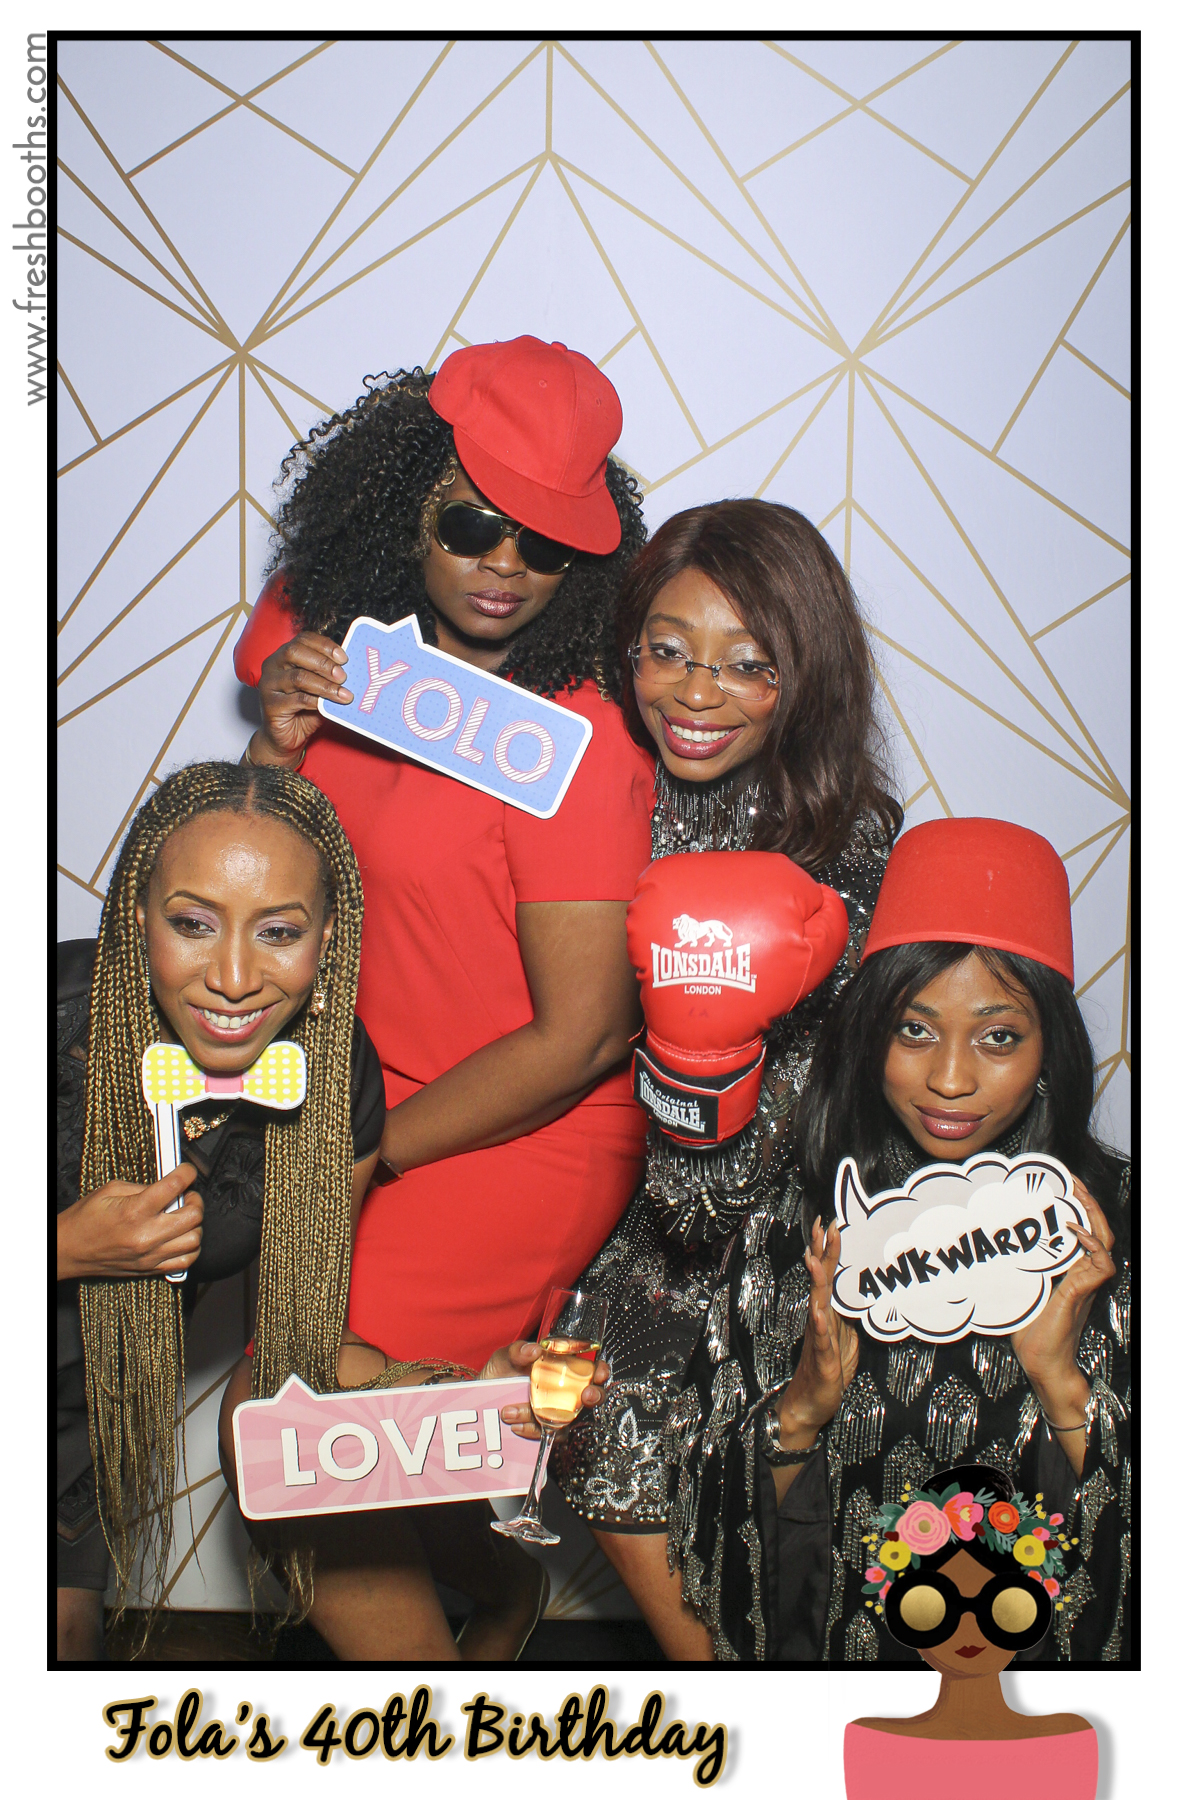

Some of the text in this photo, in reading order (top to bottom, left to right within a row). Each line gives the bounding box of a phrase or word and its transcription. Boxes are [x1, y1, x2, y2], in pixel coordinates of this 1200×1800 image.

[358, 646, 556, 784] YOLO
[651, 942, 756, 993] LONSDALE
[684, 985, 722, 995] LONDON
[639, 1072, 705, 1133] LONSDALE
[653, 1108, 678, 1128] LONDON
[858, 1204, 1065, 1300] AWKWARD!
[280, 1408, 504, 1487] LOVE!
